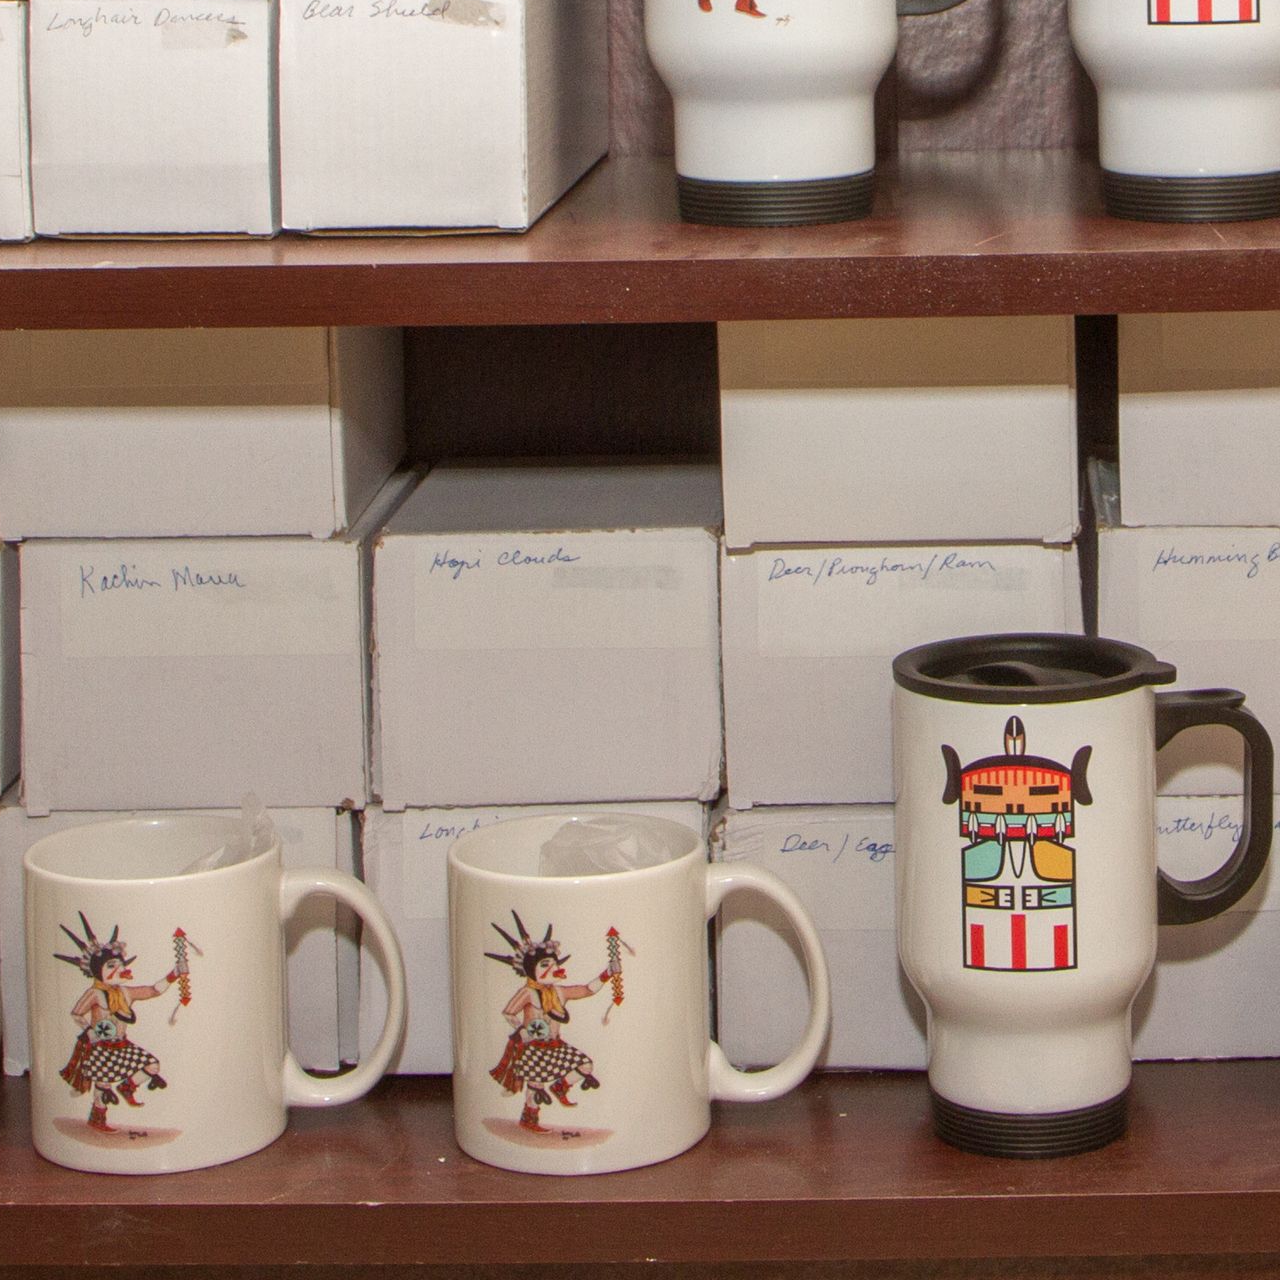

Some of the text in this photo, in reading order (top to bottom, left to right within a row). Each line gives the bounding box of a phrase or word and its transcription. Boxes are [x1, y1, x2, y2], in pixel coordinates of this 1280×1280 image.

[302, 0, 355, 20] Bear
[46, 11, 140, 40] Longhair
[430, 547, 582, 577] Hopi Clouds
[1152, 546, 1261, 579] Humming
[80, 564, 161, 598] Kachin
[1156, 812, 1243, 842] utterfly
[780, 833, 830, 853] Deer
